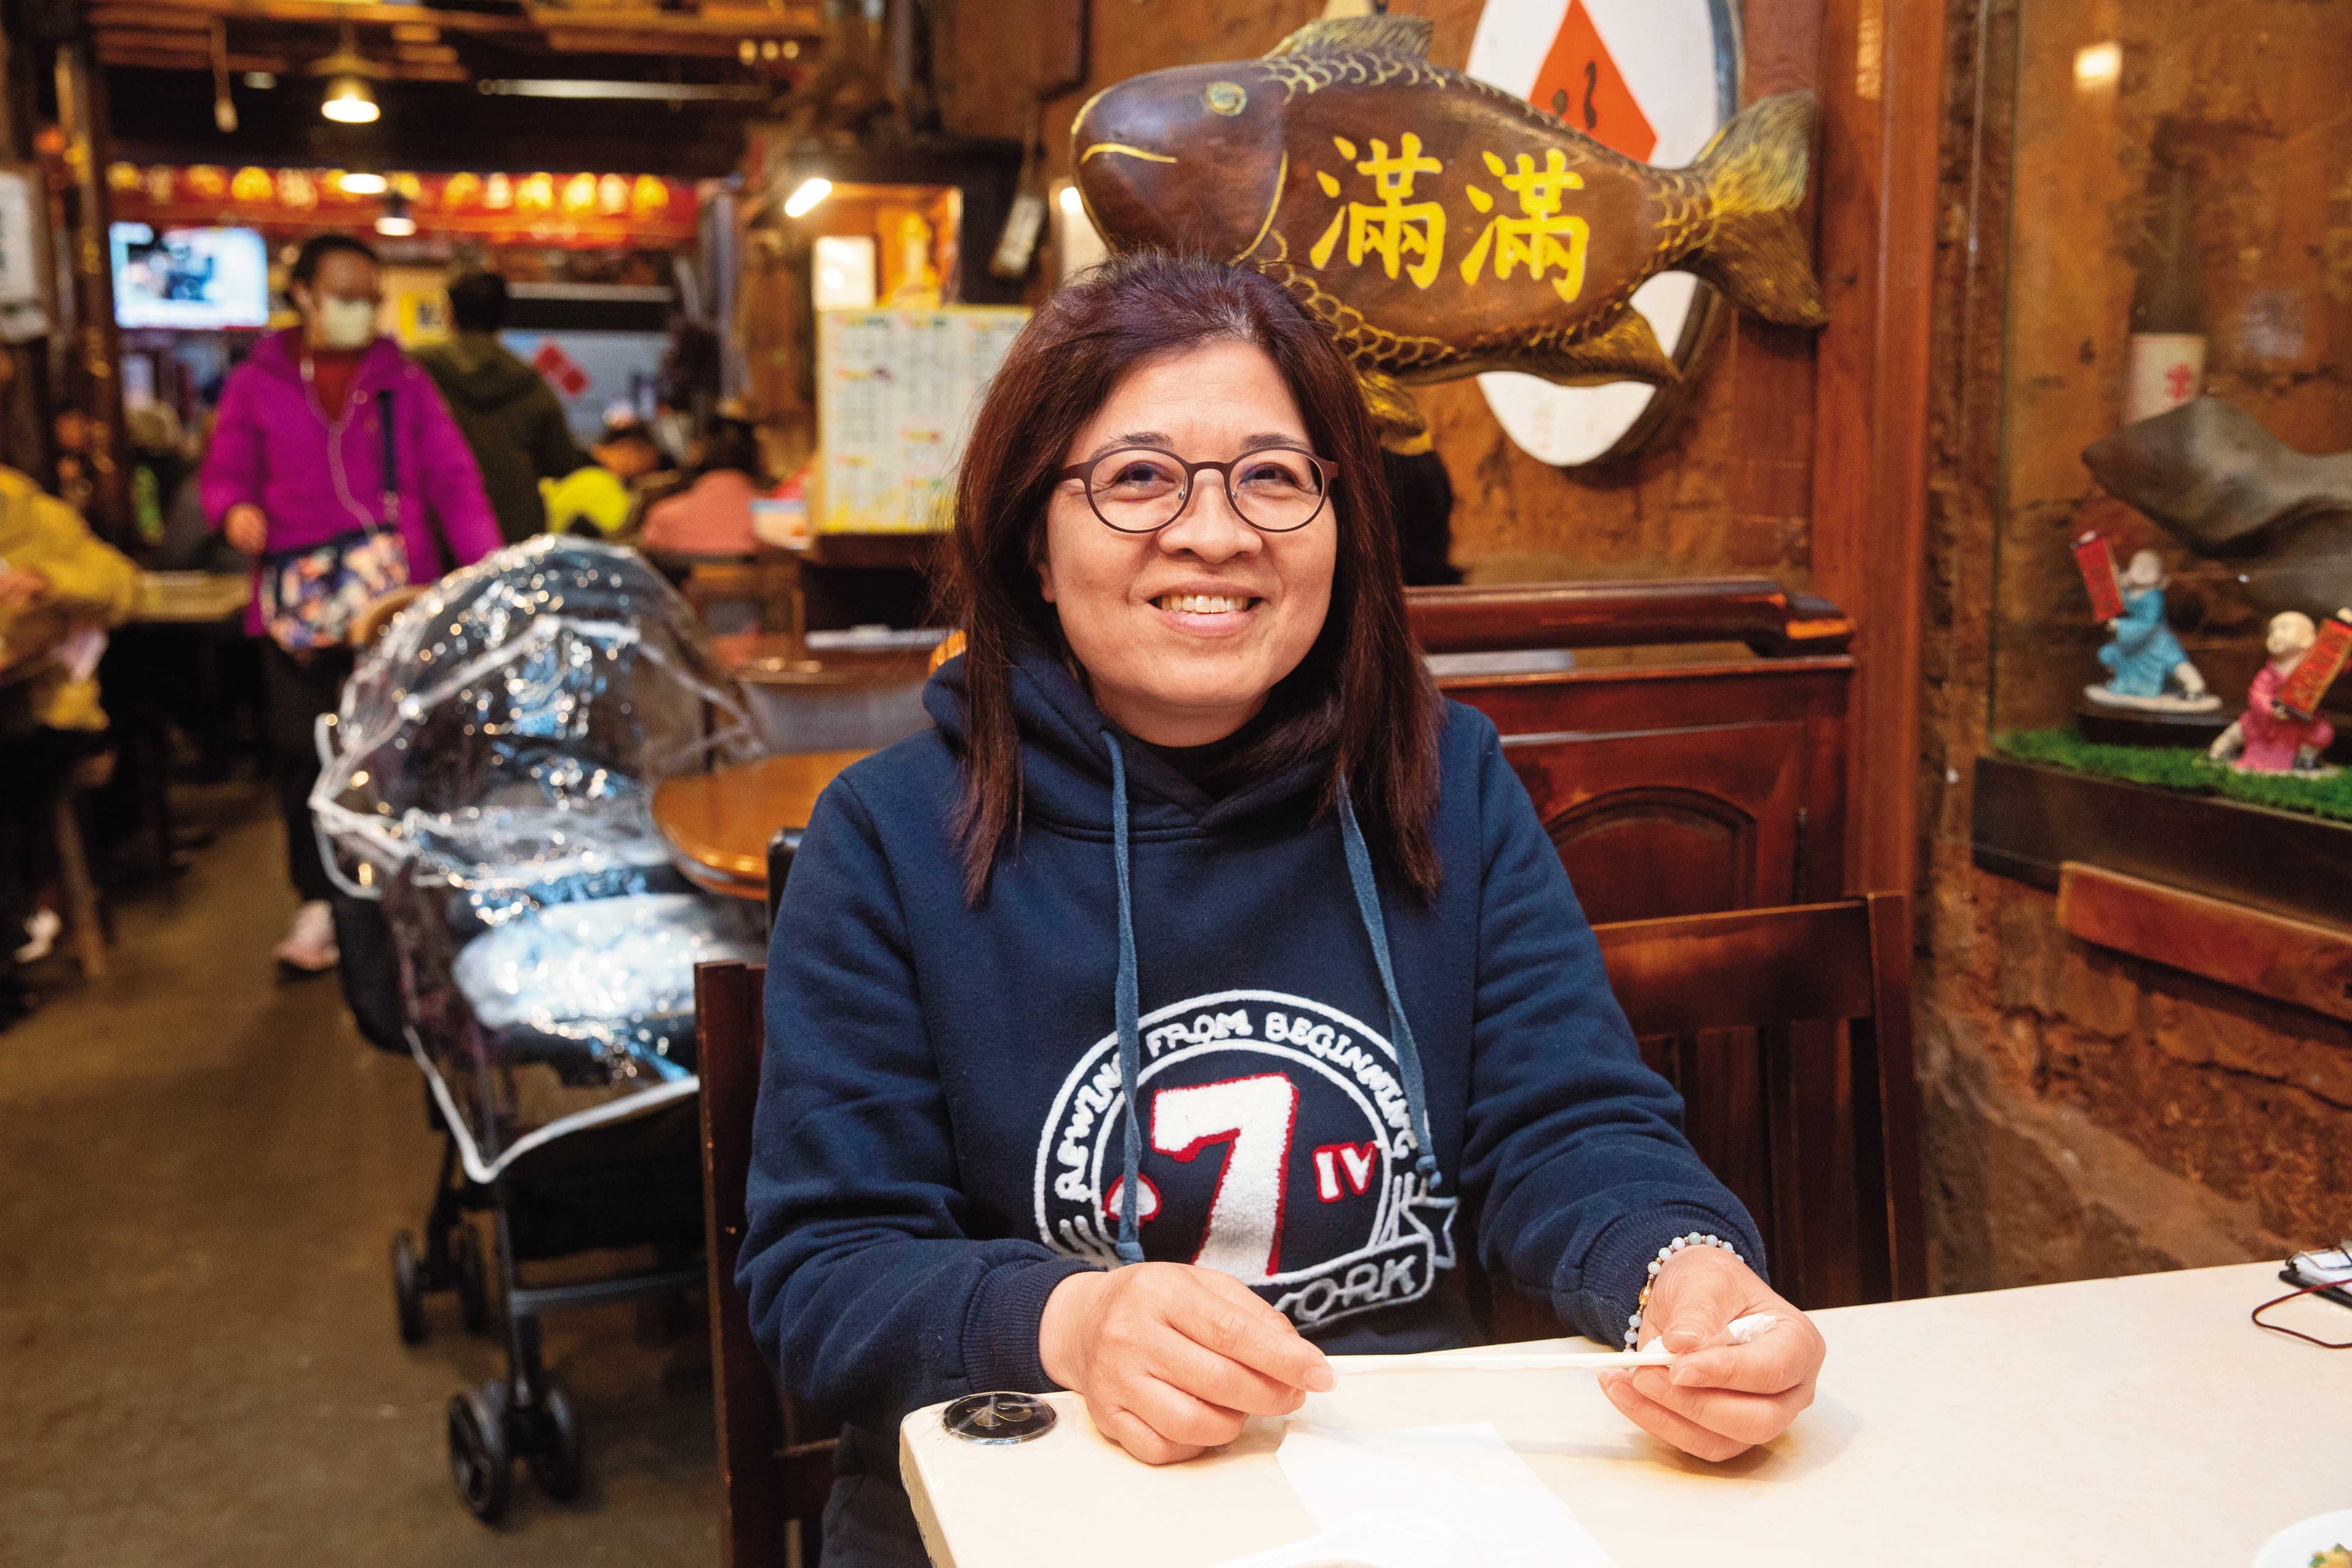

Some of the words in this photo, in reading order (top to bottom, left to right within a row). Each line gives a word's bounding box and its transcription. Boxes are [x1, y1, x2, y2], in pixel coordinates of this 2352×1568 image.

[1310, 132, 1589, 303] 滿滿
[1055, 1052, 1122, 1202] REWIN
[1145, 1009, 1253, 1058] FROM
[1265, 1012, 1417, 1159] BEGINNING
[1150, 1072, 1299, 1286] 7
[1312, 1141, 1378, 1204] IV
